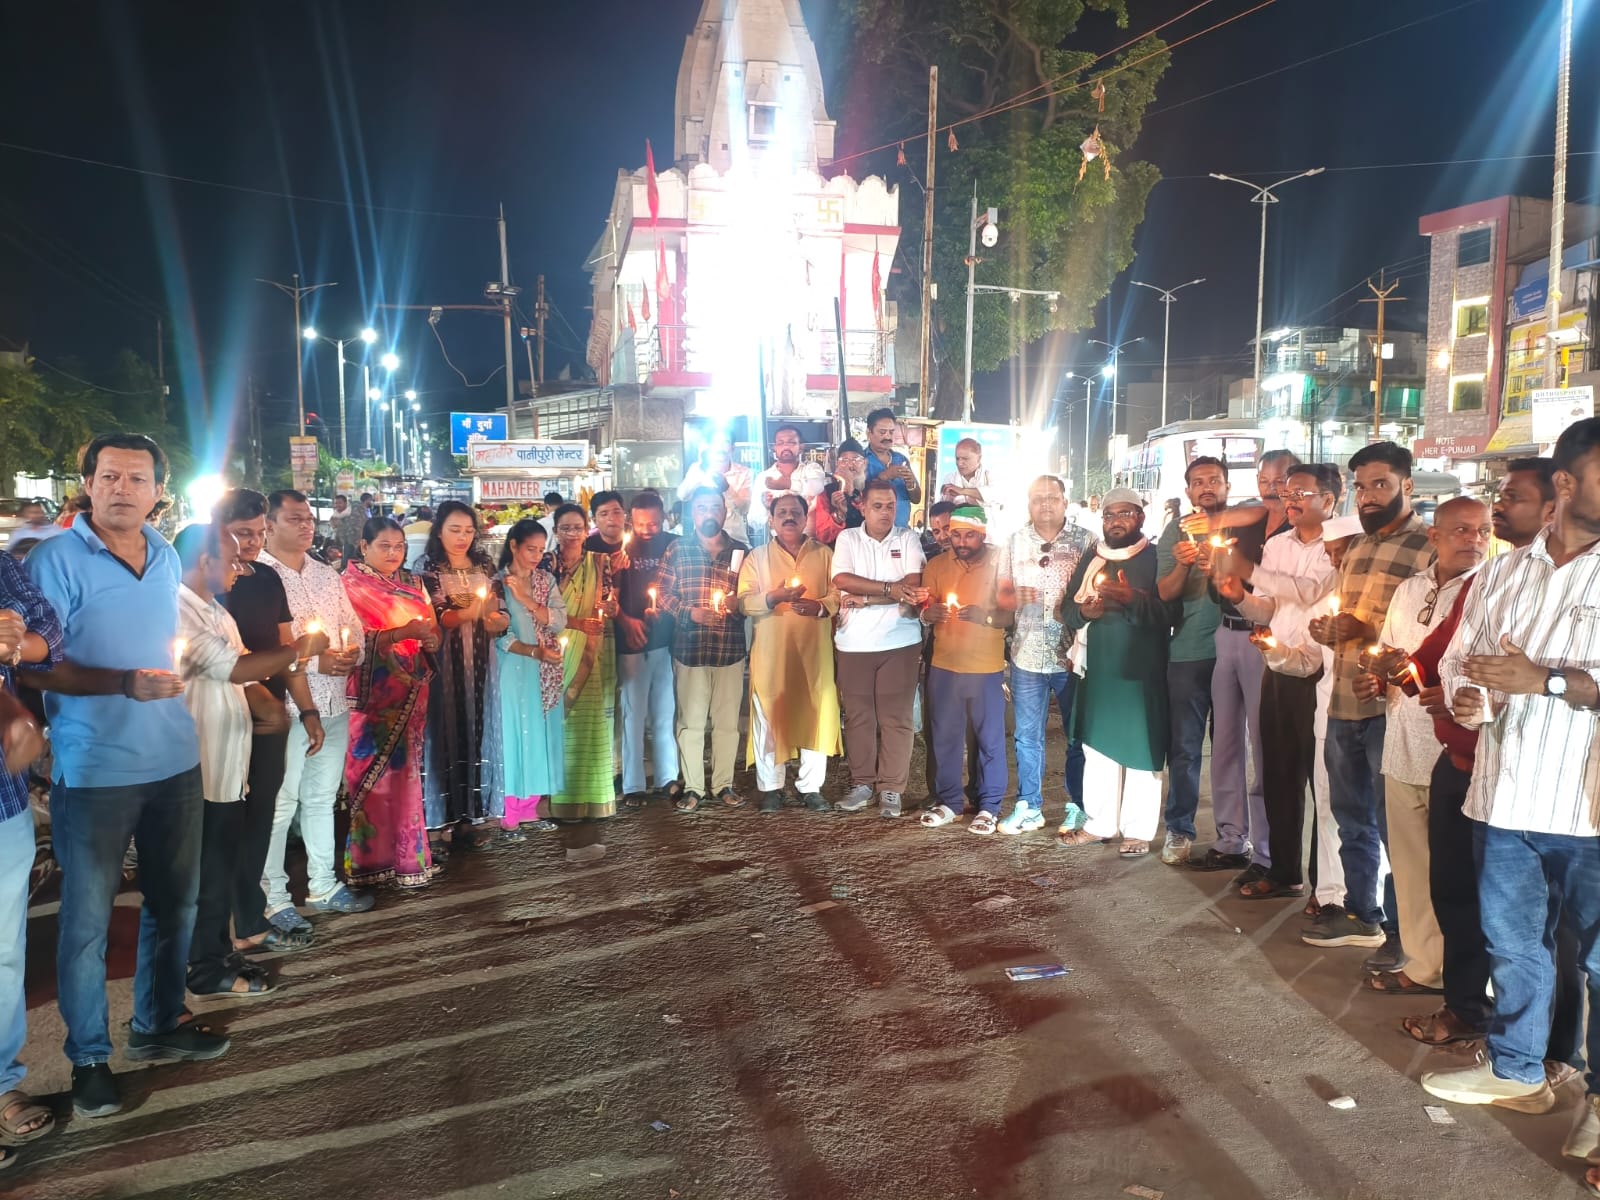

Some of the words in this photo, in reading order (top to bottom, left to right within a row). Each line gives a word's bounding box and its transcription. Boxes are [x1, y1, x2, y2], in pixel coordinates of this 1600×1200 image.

[475, 443, 513, 463] महावीर
[516, 445, 554, 464] पानीपुरी
[555, 445, 583, 461] सेन्टर
[482, 481, 540, 497] MAHAVEER
